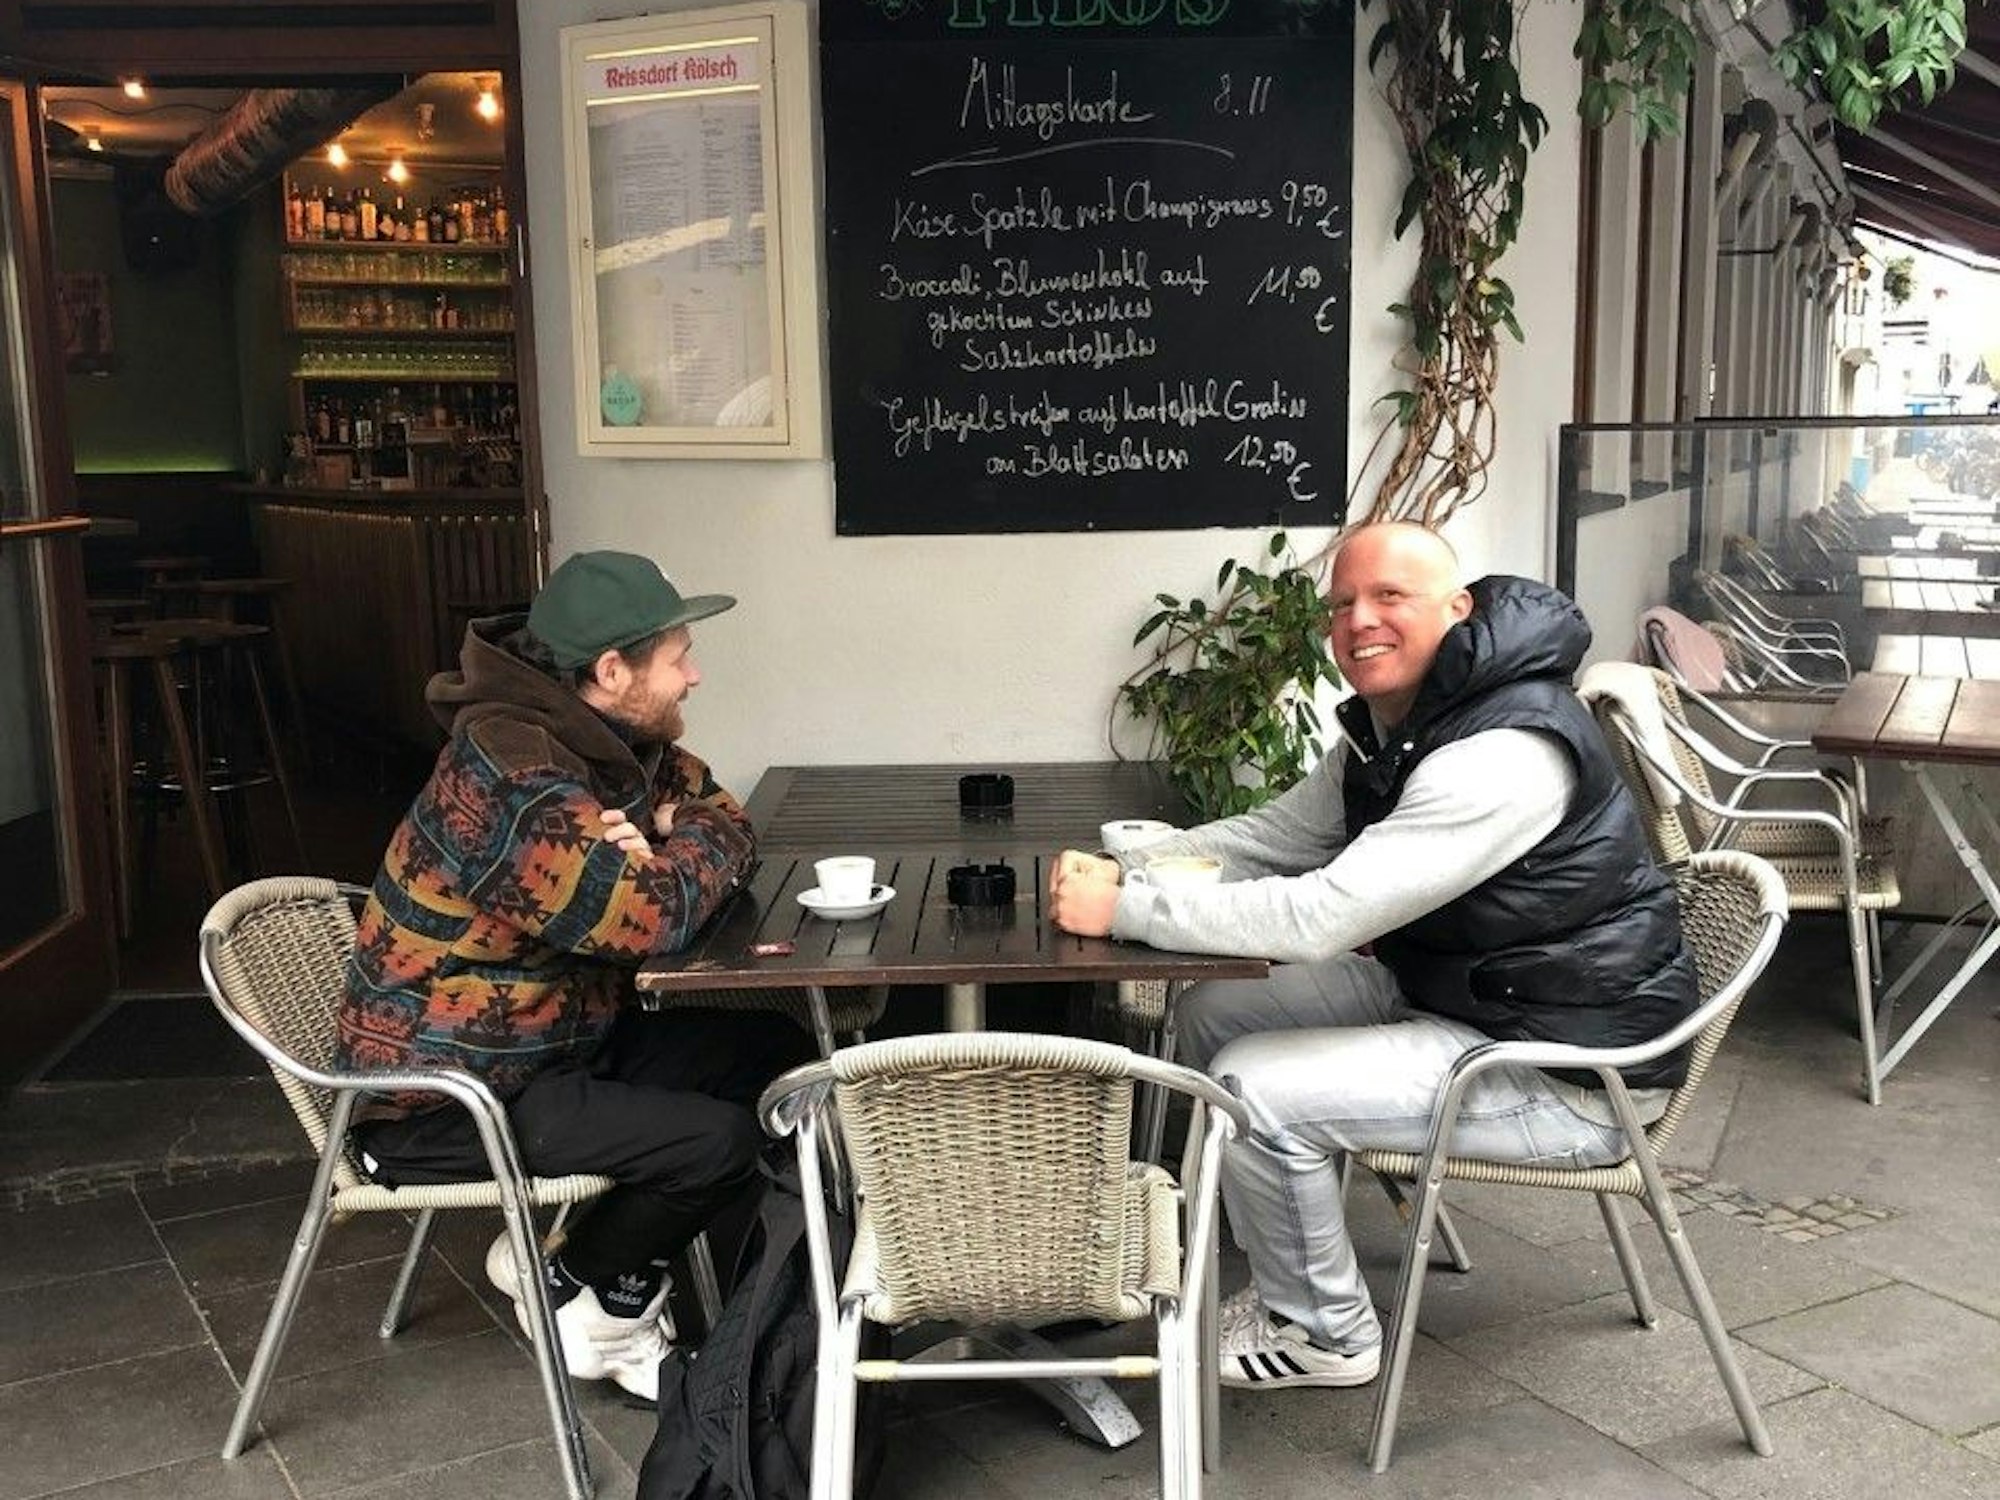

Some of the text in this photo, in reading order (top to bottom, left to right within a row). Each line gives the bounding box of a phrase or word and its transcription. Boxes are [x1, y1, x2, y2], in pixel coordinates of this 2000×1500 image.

[606, 55, 737, 88] Reissdorf Kölsch
[960, 56, 1154, 140] Mittagskarte
[1077, 175, 1117, 228] mit
[1124, 181, 1273, 229] Champignons
[1281, 180, 1328, 228] 9,50
[993, 248, 1151, 299] Blumenkohl
[1159, 254, 1210, 296] auf
[1247, 266, 1322, 304] 11,50
[1041, 296, 1152, 328] Schinken
[1314, 296, 1337, 333] €
[959, 327, 1156, 372] Salzkartoffeln
[1078, 394, 1118, 435] auf
[1223, 379, 1308, 422] Gratin
[1223, 433, 1319, 502] 12,50 €
[607, 1290, 642, 1306] adidas
